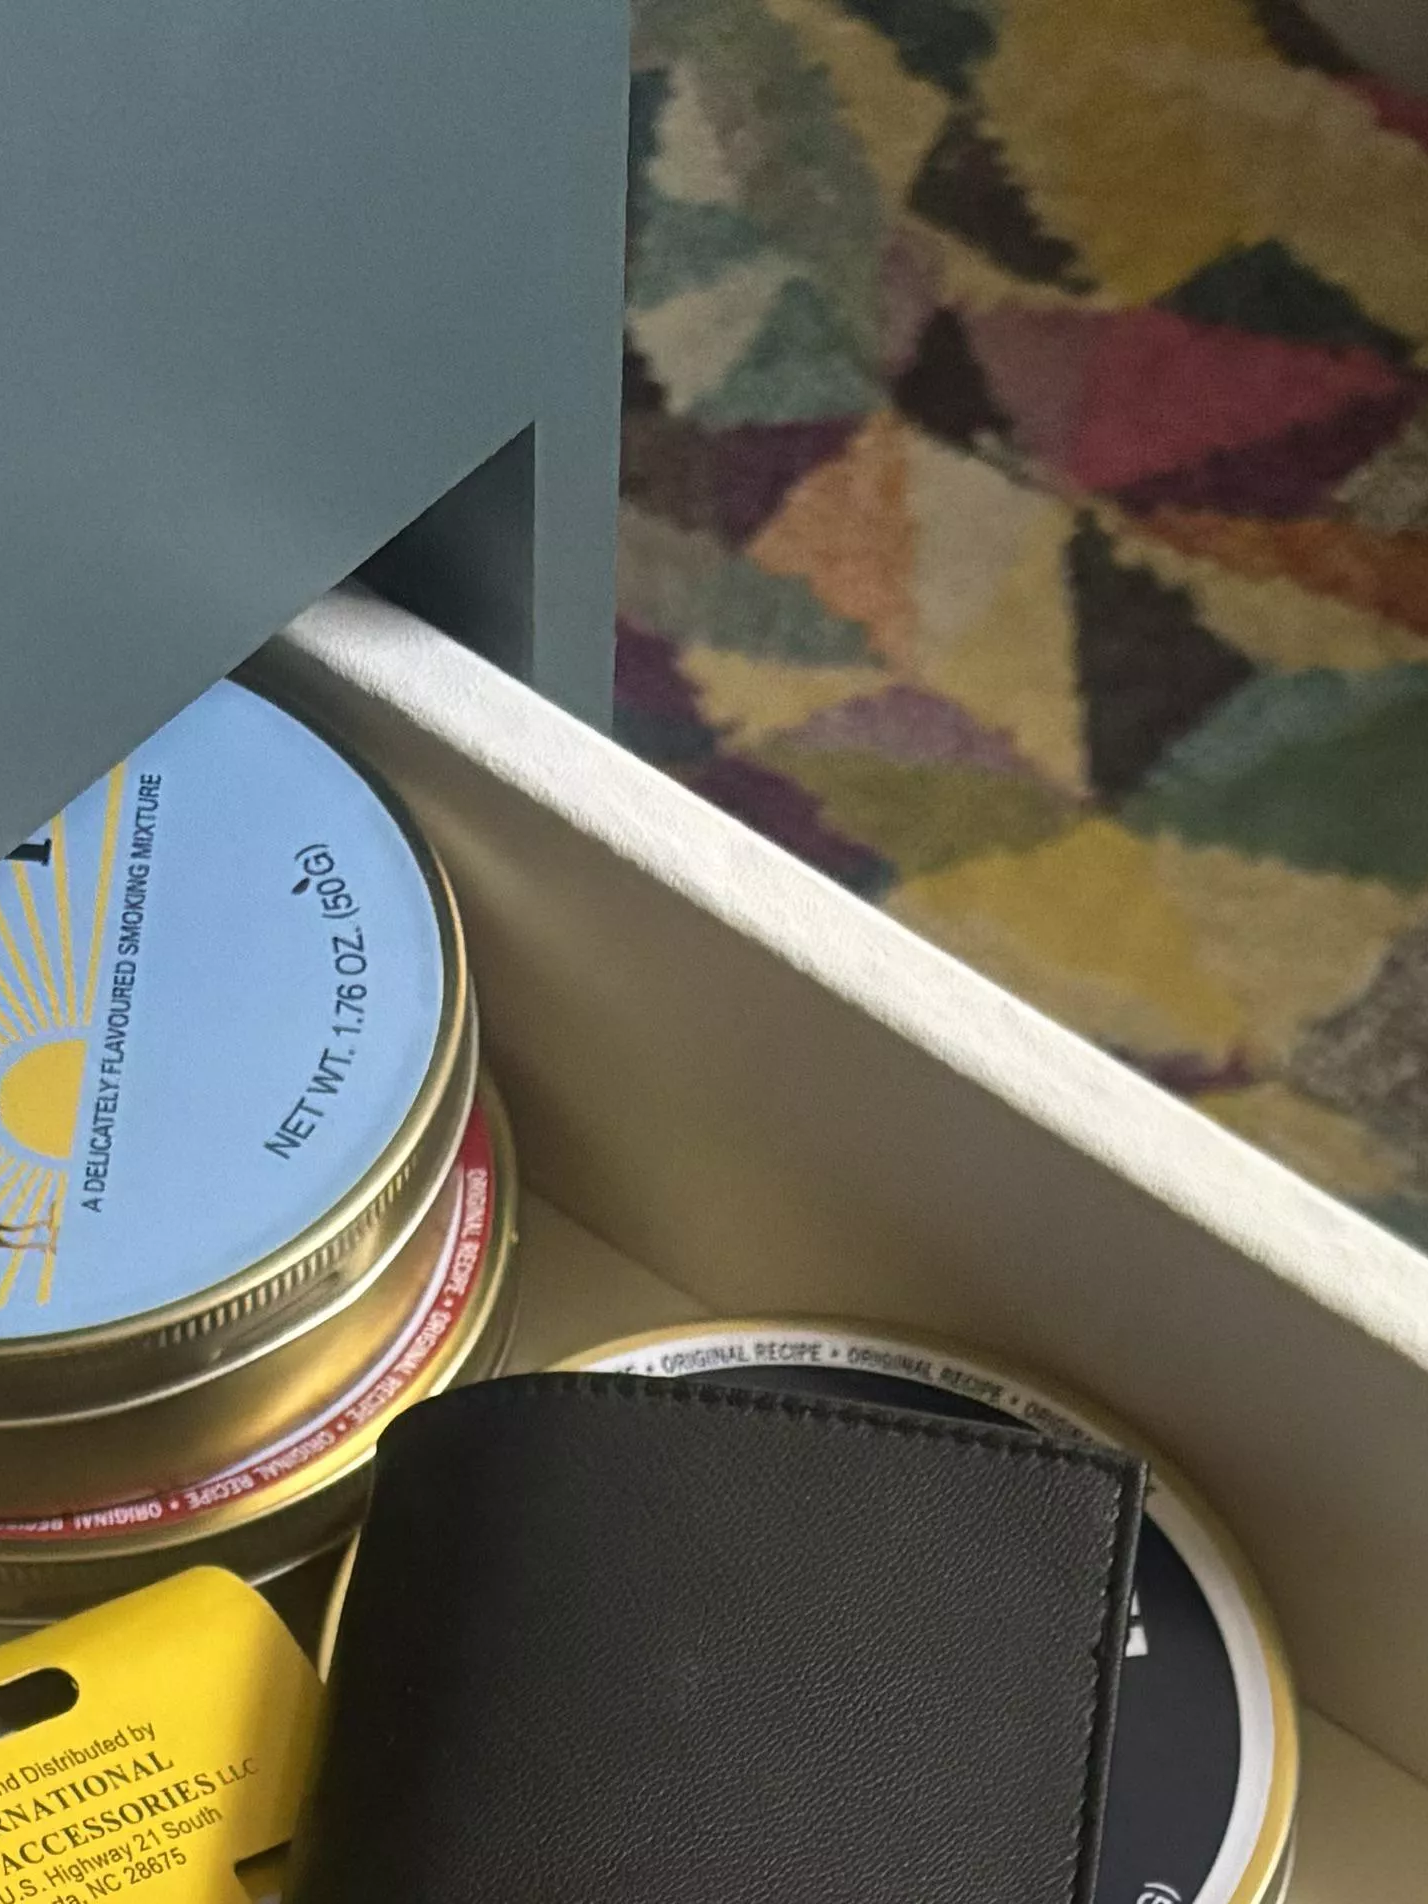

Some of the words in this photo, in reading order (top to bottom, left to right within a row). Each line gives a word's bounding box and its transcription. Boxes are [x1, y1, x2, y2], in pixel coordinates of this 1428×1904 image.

[129, 772, 162, 859] MIXTURE
[117, 862, 151, 957] SMOKING
[333, 925, 367, 976] OZ.
[100, 959, 136, 1076] FLAVOURED
[333, 984, 367, 1037] 1.76
[307, 1048, 356, 1095] WT.
[83, 1080, 120, 1192] DELICATELY
[263, 1097, 324, 1159] NET
[394, 1310, 450, 1377] ORIGINAL
[661, 1344, 750, 1374] ORIGINAL
[755, 1343, 821, 1362] RECIPE
[848, 1347, 932, 1379] ORIGINAL
[941, 1367, 1004, 1400] RECIPE
[253, 1428, 336, 1480] ORIGINAL
[186, 1477, 253, 1509] RECIPE
[19, 1728, 128, 1786] Distributed
[126, 1719, 156, 1744] by
[0, 1770, 216, 1876] ACCESSORIES
[215, 1756, 258, 1786] LLC
[45, 1840, 134, 1890] Highway
[132, 1827, 160, 1852] 21
[161, 1804, 223, 1840] South
[87, 1872, 122, 1900] NC
[123, 1846, 187, 1886] 28675
